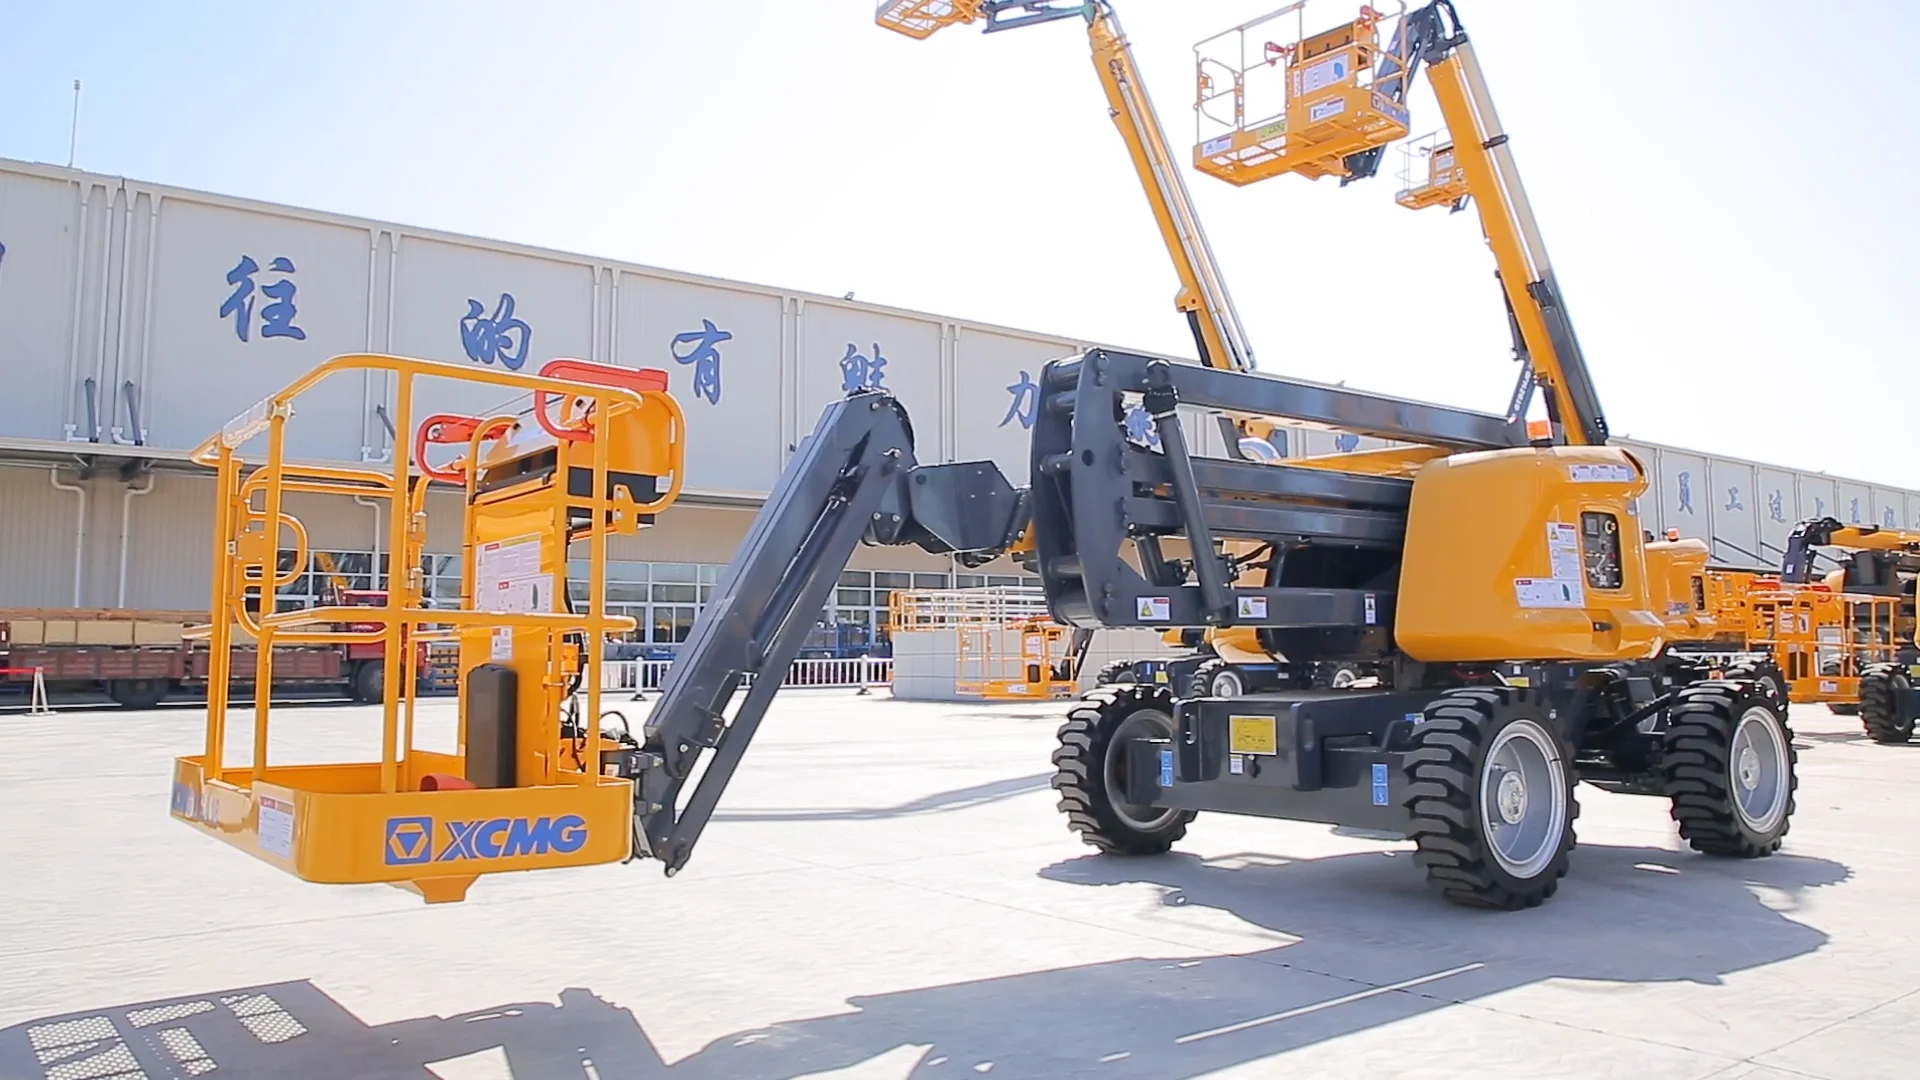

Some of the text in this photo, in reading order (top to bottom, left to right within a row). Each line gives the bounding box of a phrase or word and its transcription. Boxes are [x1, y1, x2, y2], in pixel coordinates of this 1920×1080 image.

[220, 255, 306, 342] 往
[460, 293, 532, 370] 的
[671, 319, 733, 404] 有
[435, 814, 588, 862] XCMG
